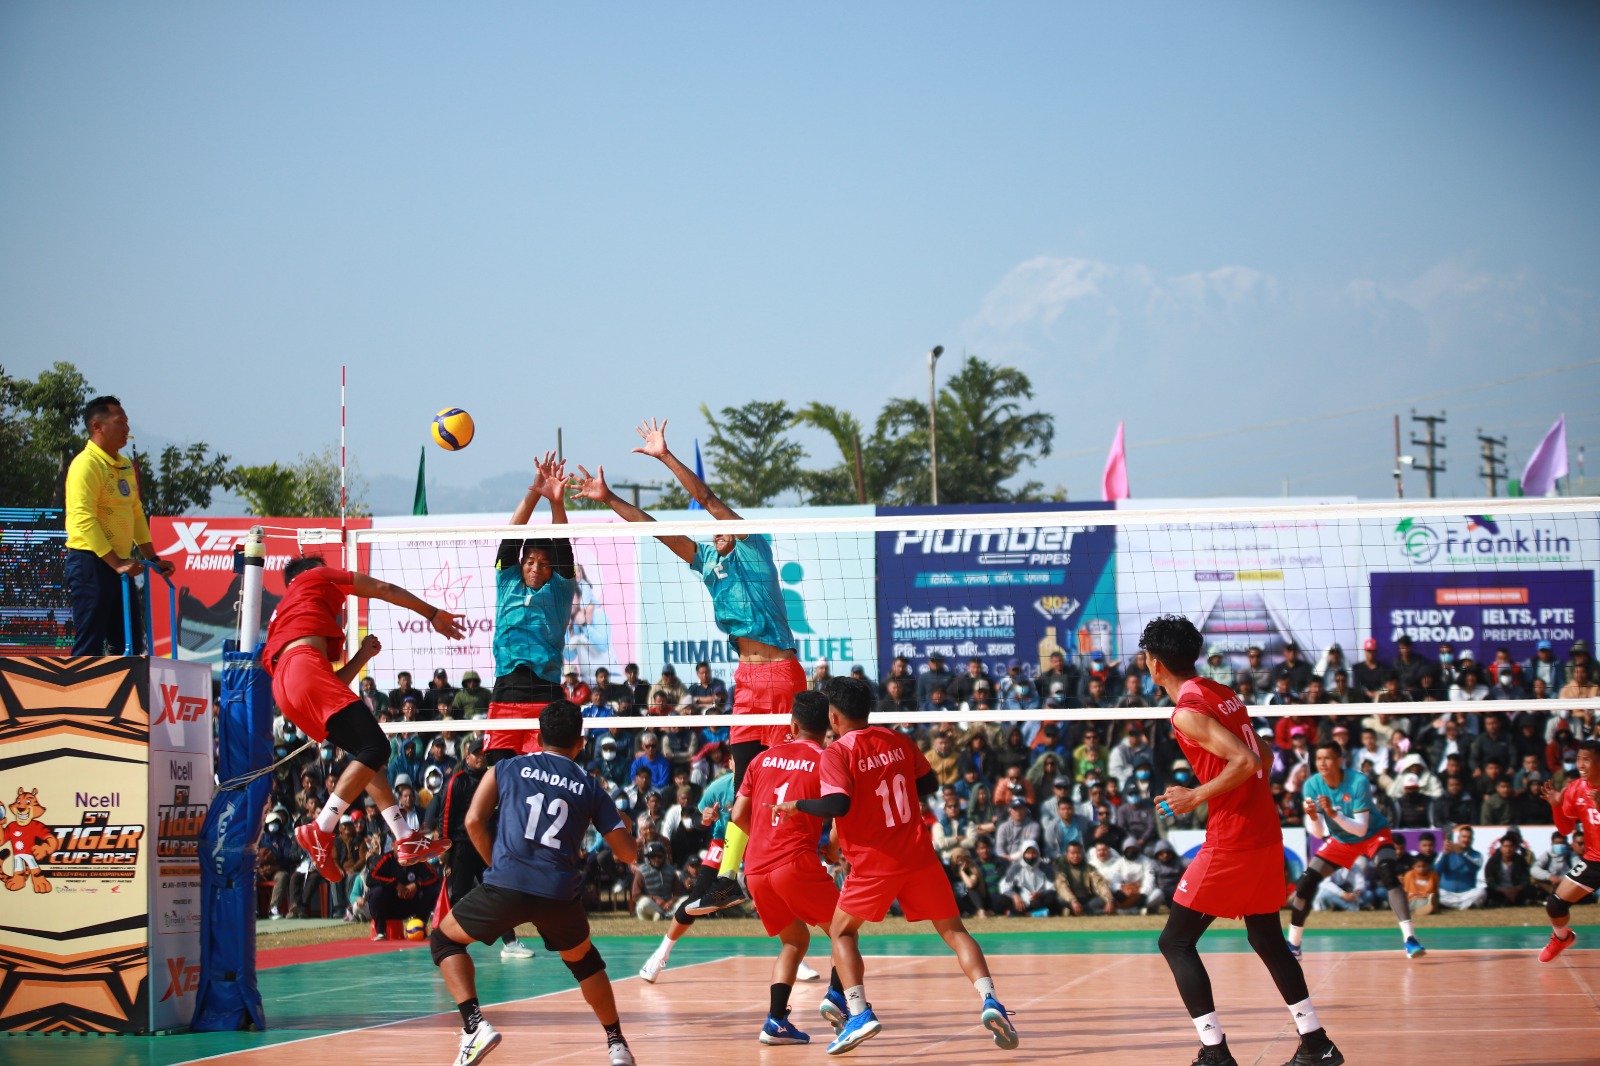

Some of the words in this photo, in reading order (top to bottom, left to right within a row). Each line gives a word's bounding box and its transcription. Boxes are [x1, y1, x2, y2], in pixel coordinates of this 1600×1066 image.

[1446, 529, 1570, 553] Franklin
[1030, 553, 1071, 565] PIPES
[1391, 609, 1456, 625] STUDY
[1482, 609, 1537, 627] IELTS,
[1539, 608, 1575, 624] PTE
[893, 629, 936, 640] PLUMBER
[938, 628, 964, 639] PIPES
[975, 627, 1015, 639] FITTINGS
[1391, 626, 1474, 642] ABROAD
[1483, 628, 1575, 641] PREPERATION
[805, 637, 853, 662] LIFE
[153, 683, 208, 725] XTEP
[170, 760, 193, 780] Ncell
[762, 756, 815, 773] GANDAKI
[857, 747, 906, 773] GANDAKI
[520, 766, 585, 796] GANDAKI
[75, 792, 121, 808] Ncell
[874, 773, 913, 828] 10
[83, 812, 109, 824] 5TH
[158, 805, 207, 837] TIGER
[524, 792, 569, 850] 12
[54, 826, 143, 850] TIGER
[158, 840, 179, 856] CUP
[180, 840, 199, 855] 202
[50, 851, 90, 864] CUP
[91, 852, 137, 864] 2025
[707, 846, 724, 863] 10
[160, 957, 200, 1002] XTE
